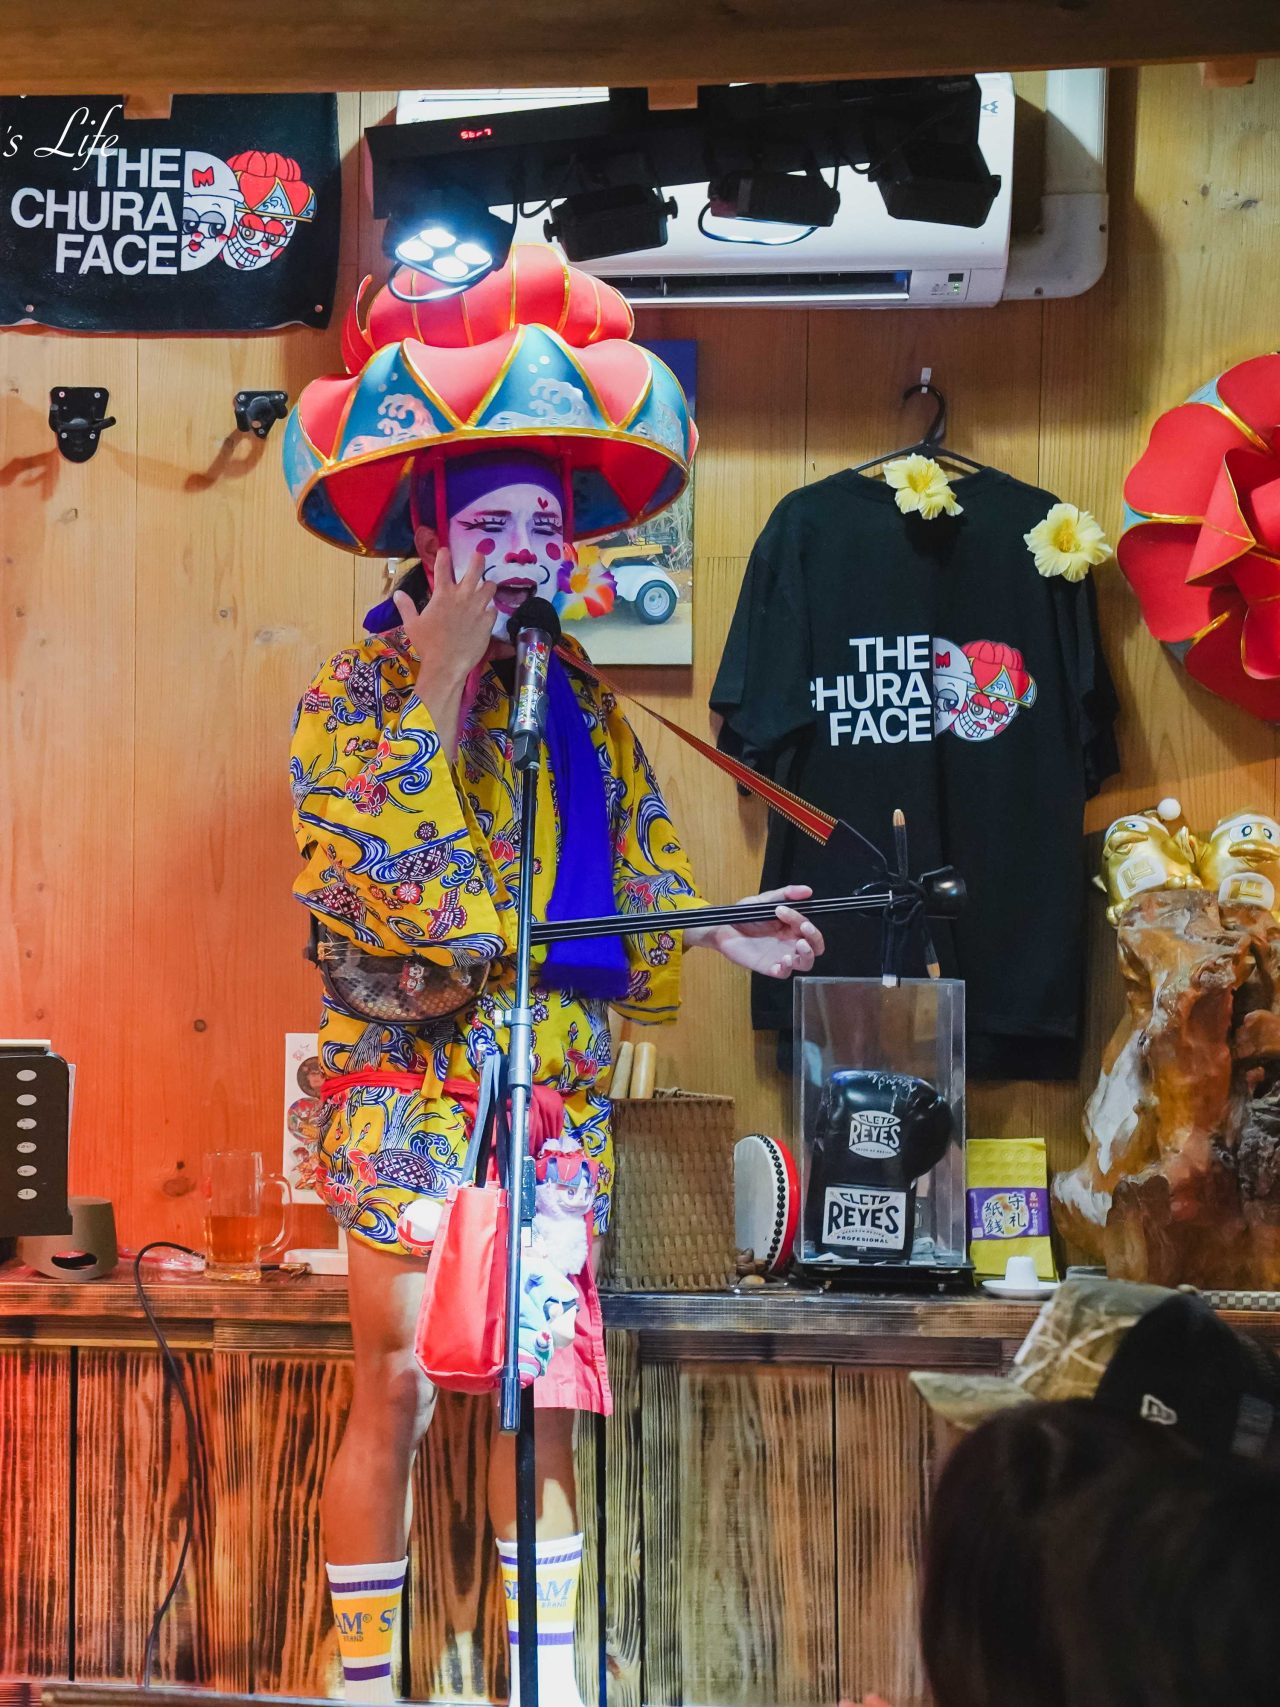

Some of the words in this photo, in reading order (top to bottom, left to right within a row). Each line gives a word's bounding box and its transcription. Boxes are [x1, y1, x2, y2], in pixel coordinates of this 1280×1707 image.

[88, 147, 181, 188] THE
[192, 165, 215, 188] M
[10, 187, 178, 232] CHURA
[55, 233, 178, 275] FACE
[849, 634, 930, 672] THE
[810, 671, 932, 711] HURA
[829, 707, 932, 746] FACE
[849, 1120, 901, 1149] REYES
[827, 1201, 900, 1236] REYES
[836, 1235, 889, 1244] PROFESIONAL
